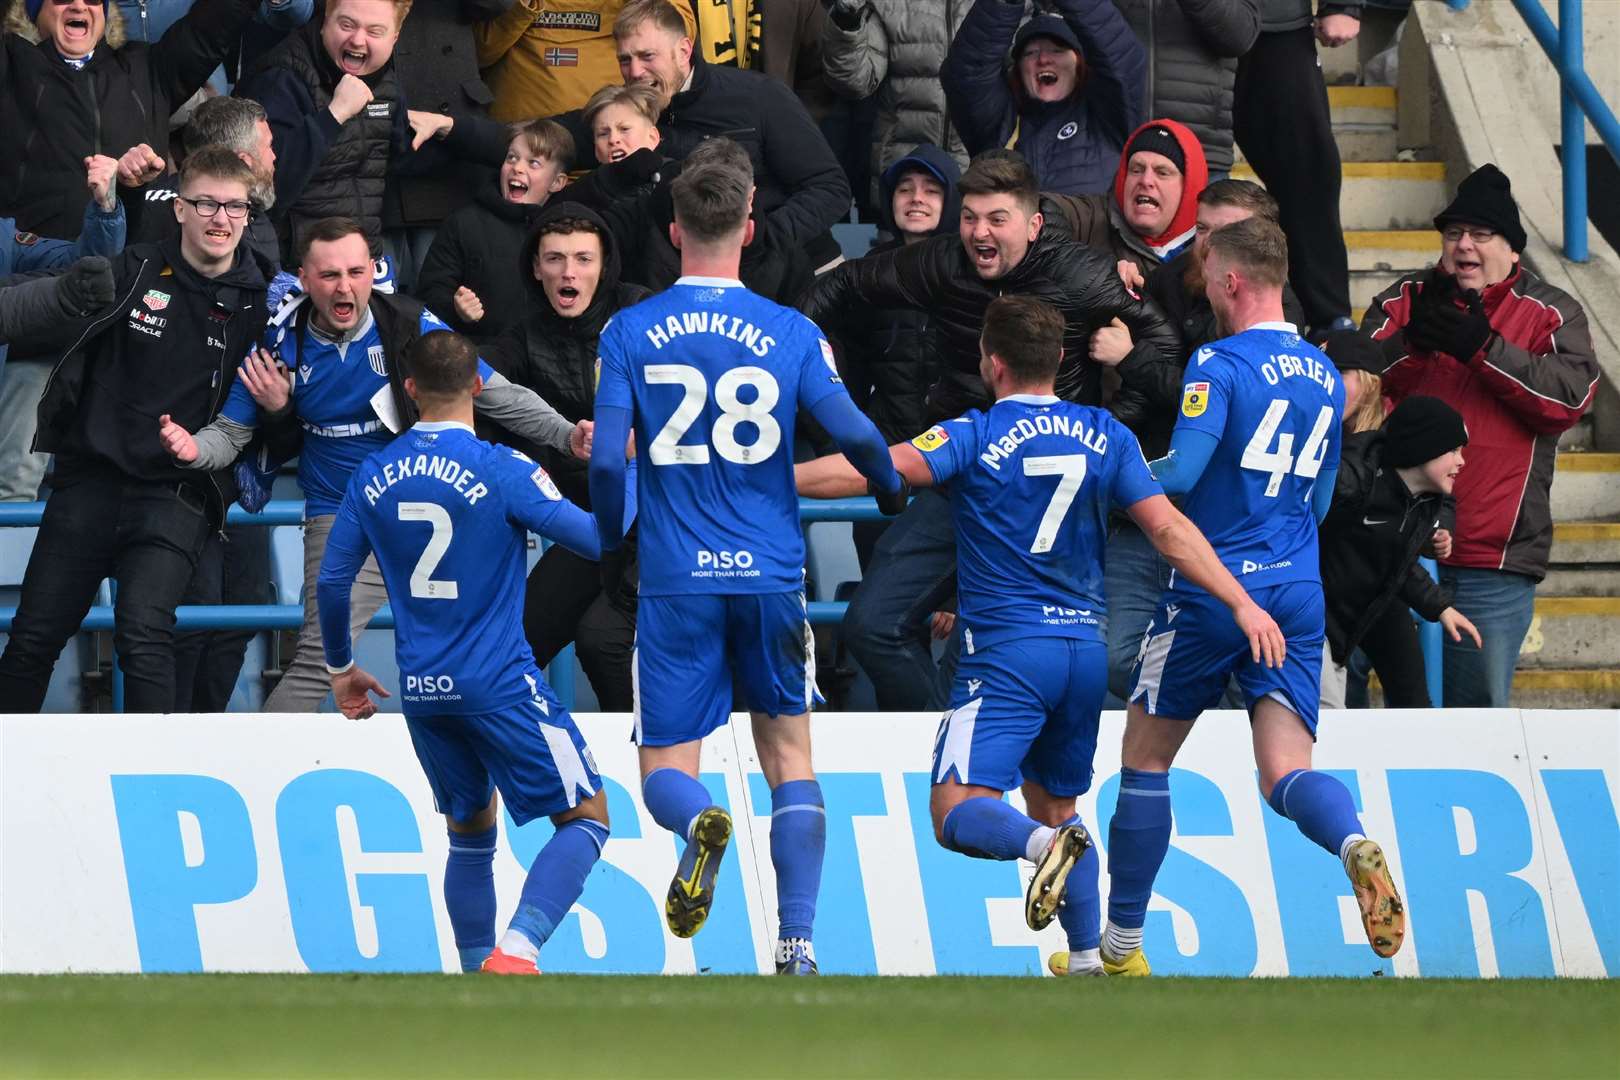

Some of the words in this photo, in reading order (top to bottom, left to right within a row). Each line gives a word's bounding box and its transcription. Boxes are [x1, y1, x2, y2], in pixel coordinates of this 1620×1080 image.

[129, 320, 162, 337] ORACLE
[130, 308, 157, 325] Mobil
[646, 312, 776, 357] HAWKINS
[1261, 354, 1335, 396] O'BRIEN
[644, 364, 781, 466] 28
[981, 416, 1107, 470] MacDONALD
[1240, 399, 1334, 502] 44
[364, 454, 488, 506] ALEXANDER
[1022, 454, 1086, 554] 7
[398, 502, 458, 599] 2
[697, 550, 753, 569] PISO
[691, 570, 713, 578] MORE
[736, 569, 761, 577] FLOOR
[406, 675, 454, 693] PISO
[420, 694, 438, 702] THAN
[110, 768, 443, 974] PG
